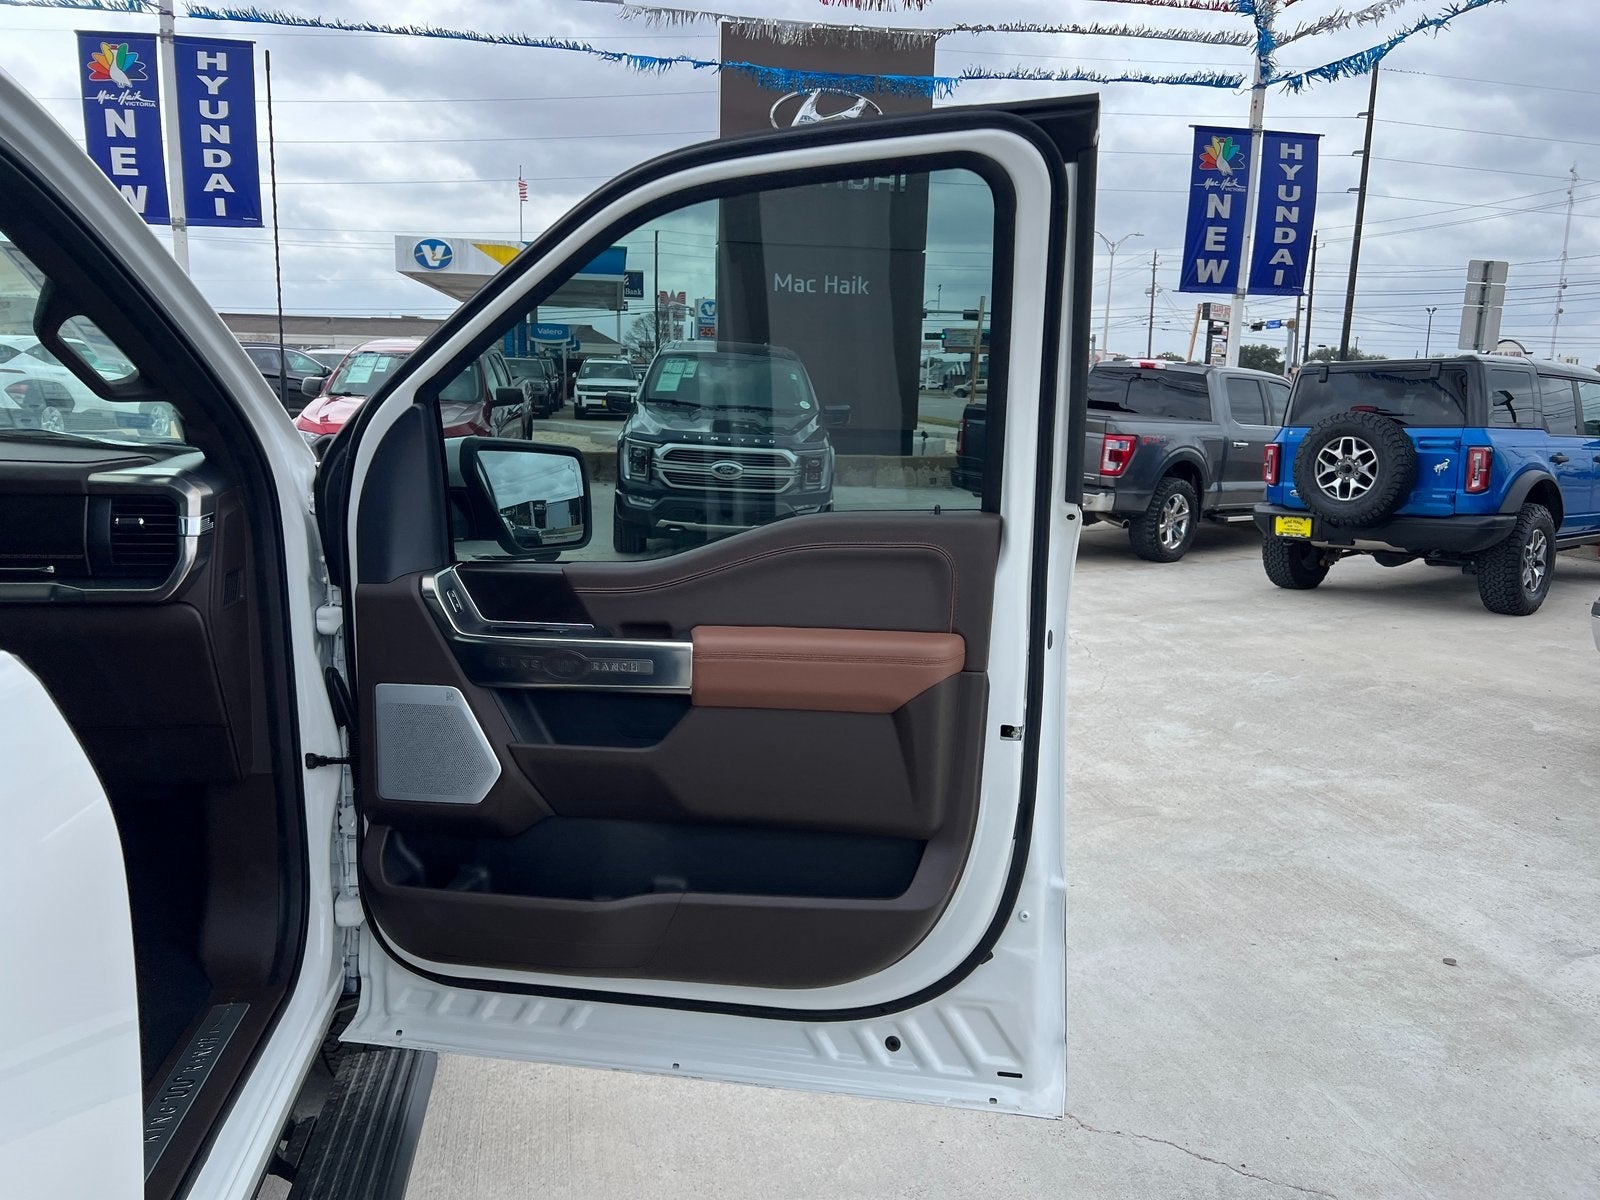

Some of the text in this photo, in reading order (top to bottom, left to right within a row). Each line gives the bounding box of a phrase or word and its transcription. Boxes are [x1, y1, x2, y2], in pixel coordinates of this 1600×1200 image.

[196, 51, 235, 216] HYUNDAI
[1269, 143, 1303, 286] HYUNDAI
[1196, 193, 1232, 284] NEW
[774, 273, 869, 294] Mac Haik
[625, 288, 642, 296] Bank
[537, 327, 563, 335] Valero
[683, 434, 776, 444] LIMITED
[591, 661, 638, 673] RANCH
